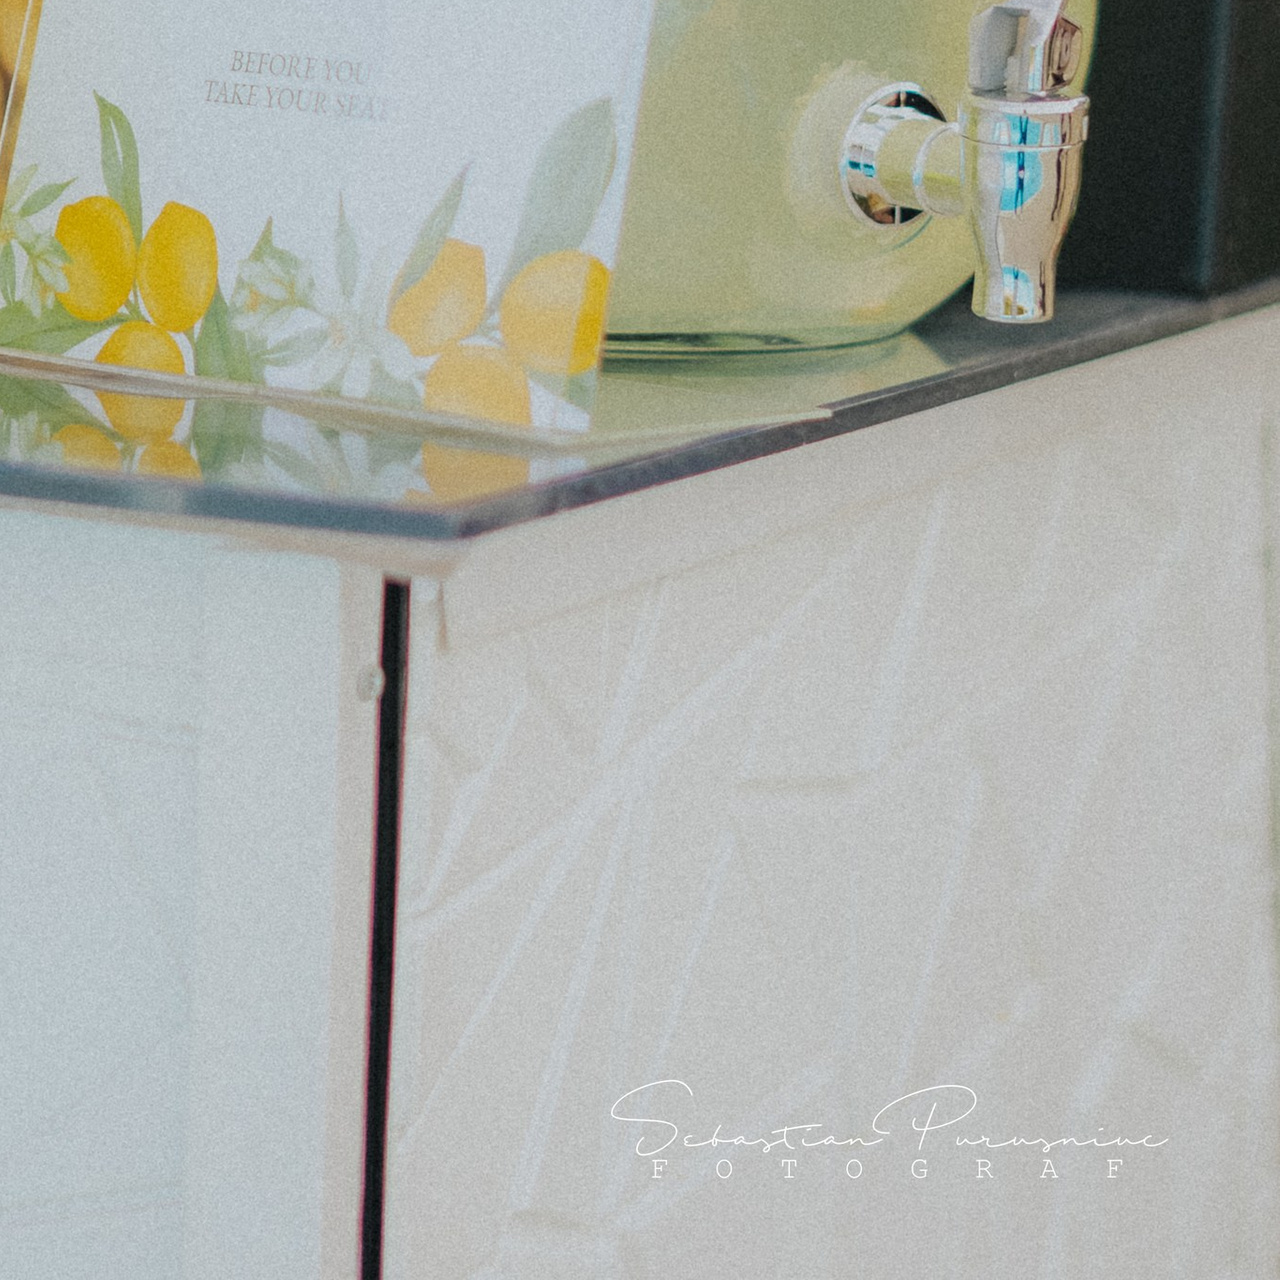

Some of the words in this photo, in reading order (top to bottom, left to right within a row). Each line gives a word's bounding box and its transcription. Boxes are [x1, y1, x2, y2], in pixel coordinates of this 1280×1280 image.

[230, 50, 317, 80] BEFORE
[324, 59, 373, 85] YOU
[204, 80, 259, 107] TAKE
[265, 86, 327, 115] YOUR
